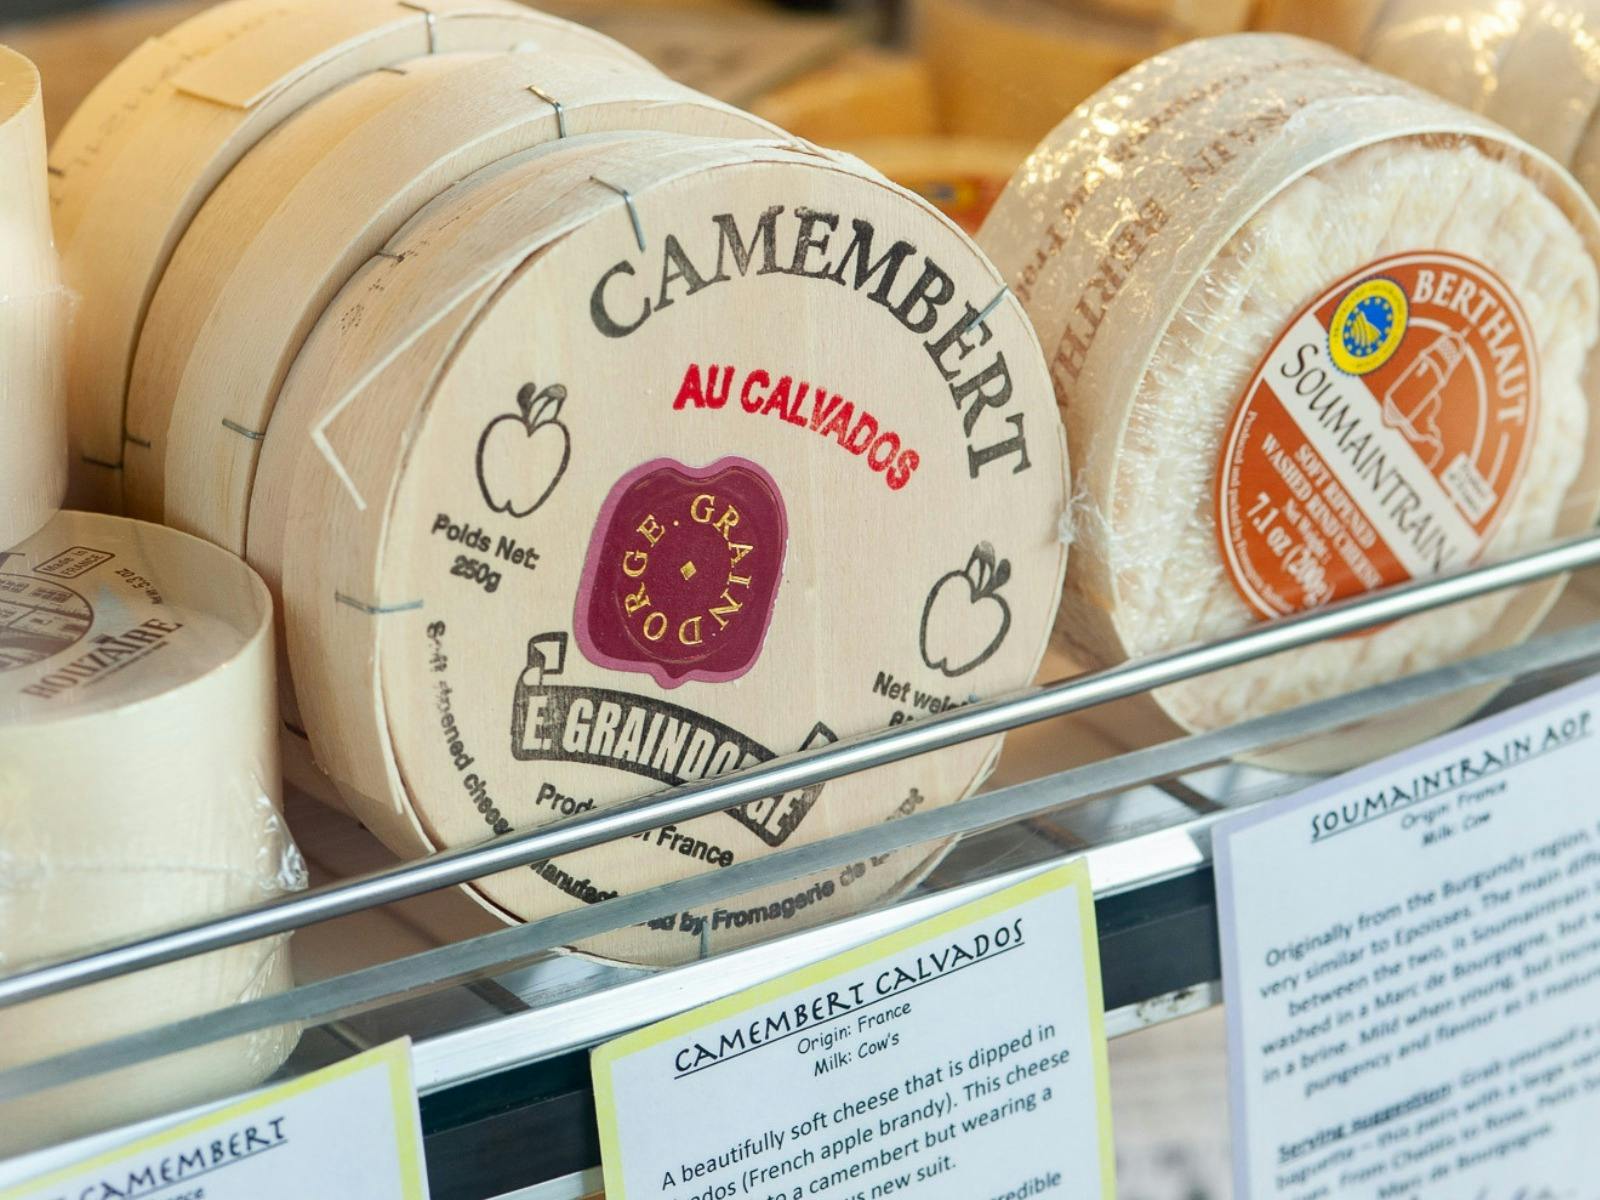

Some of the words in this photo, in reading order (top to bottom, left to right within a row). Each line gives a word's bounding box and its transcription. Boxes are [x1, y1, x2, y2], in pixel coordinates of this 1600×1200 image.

[589, 205, 1032, 479] CAMEMBERT
[1413, 269, 1526, 425] BERTHAUT
[673, 363, 735, 410] AU
[740, 369, 920, 491] CALVADOS
[1261, 432, 1313, 501] WASHED
[1281, 344, 1457, 573] SOUMAINTRAIN
[1247, 492, 1279, 533] 7.1
[449, 556, 502, 592] 250g
[873, 671, 909, 703] Net
[463, 772, 513, 835] chees
[1312, 736, 1530, 840] SOUMAINTRAIN
[1543, 711, 1590, 749] AOP
[1458, 781, 1507, 808] France
[657, 825, 734, 867] France
[1463, 813, 1491, 831] Cow
[711, 880, 834, 931] Fromagerie
[1260, 976, 1299, 999] very
[1306, 948, 1365, 980] similar
[1371, 939, 1390, 955] to
[1482, 888, 1512, 907] The
[1519, 868, 1560, 893] main
[1265, 923, 1352, 967] Originally
[1358, 905, 1401, 930] from
[1407, 892, 1435, 911] the
[1442, 855, 1526, 898] Burgundy
[1289, 976, 1368, 1017] between
[1373, 962, 1402, 982] the
[1472, 888, 1588, 941] Soumaintrain
[675, 983, 864, 1073] CAMEMBERT
[876, 918, 1025, 995] CALVADOS
[797, 1023, 851, 1055] Origin:
[858, 1002, 912, 1034] France
[1262, 1016, 1331, 1054] washed
[1336, 1011, 1353, 1026] in
[1360, 1004, 1369, 1018] a
[1375, 984, 1417, 1009] Marc
[1425, 973, 1446, 990] de
[814, 1050, 853, 1078] Milk:
[858, 1033, 900, 1060] Cow's
[1264, 1068, 1280, 1084] in
[1286, 1062, 1295, 1075] a
[1360, 1018, 1399, 1044] Mild
[1406, 1000, 1454, 1026] when
[1304, 1053, 1392, 1097] pungency
[1399, 1033, 1430, 1058] and
[662, 1172, 676, 1191] A
[681, 1129, 785, 1182] beautifully
[791, 1111, 827, 1140] soft
[833, 1087, 899, 1124] cheese
[905, 1068, 943, 1095] that
[949, 1060, 963, 1078] is
[968, 1029, 1032, 1070] dipped
[1038, 1024, 1056, 1042] in
[742, 1149, 816, 1194] (French
[821, 1127, 874, 1160] apple
[880, 1093, 958, 1136] brandy).
[963, 1076, 1001, 1102] This
[1006, 1050, 1070, 1086] cheese
[792, 1187, 803, 1199] a
[809, 1138, 919, 1193] camembert
[925, 1123, 956, 1148] but
[962, 1093, 1037, 1132] wearing
[1042, 1087, 1053, 1101] a
[1279, 1123, 1345, 1163] Serving
[80, 1116, 286, 1200] CAMEMBERT
[871, 1173, 911, 1199] new
[917, 1156, 956, 1182] suit.
